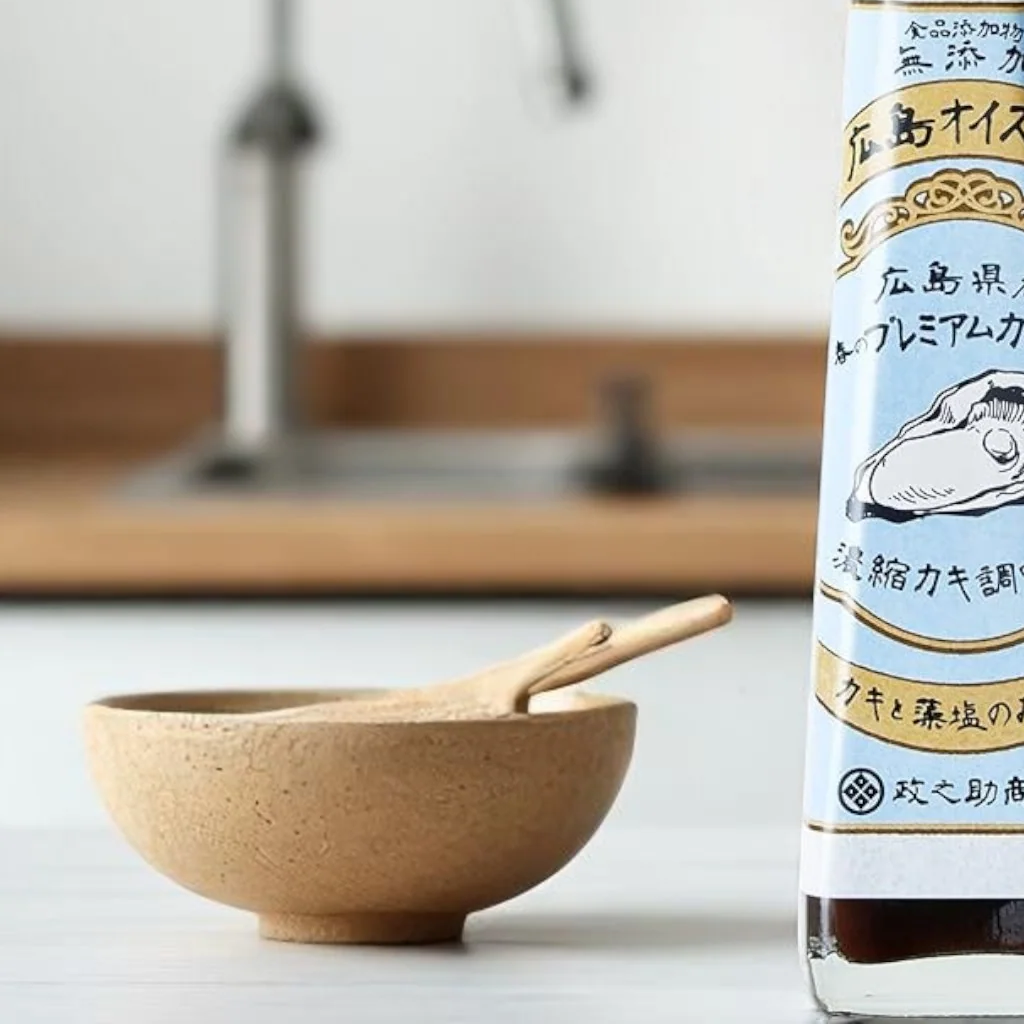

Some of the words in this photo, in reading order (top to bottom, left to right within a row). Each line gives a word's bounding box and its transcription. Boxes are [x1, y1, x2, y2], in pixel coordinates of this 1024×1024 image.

[904, 19, 1024, 42] 食品添加物
